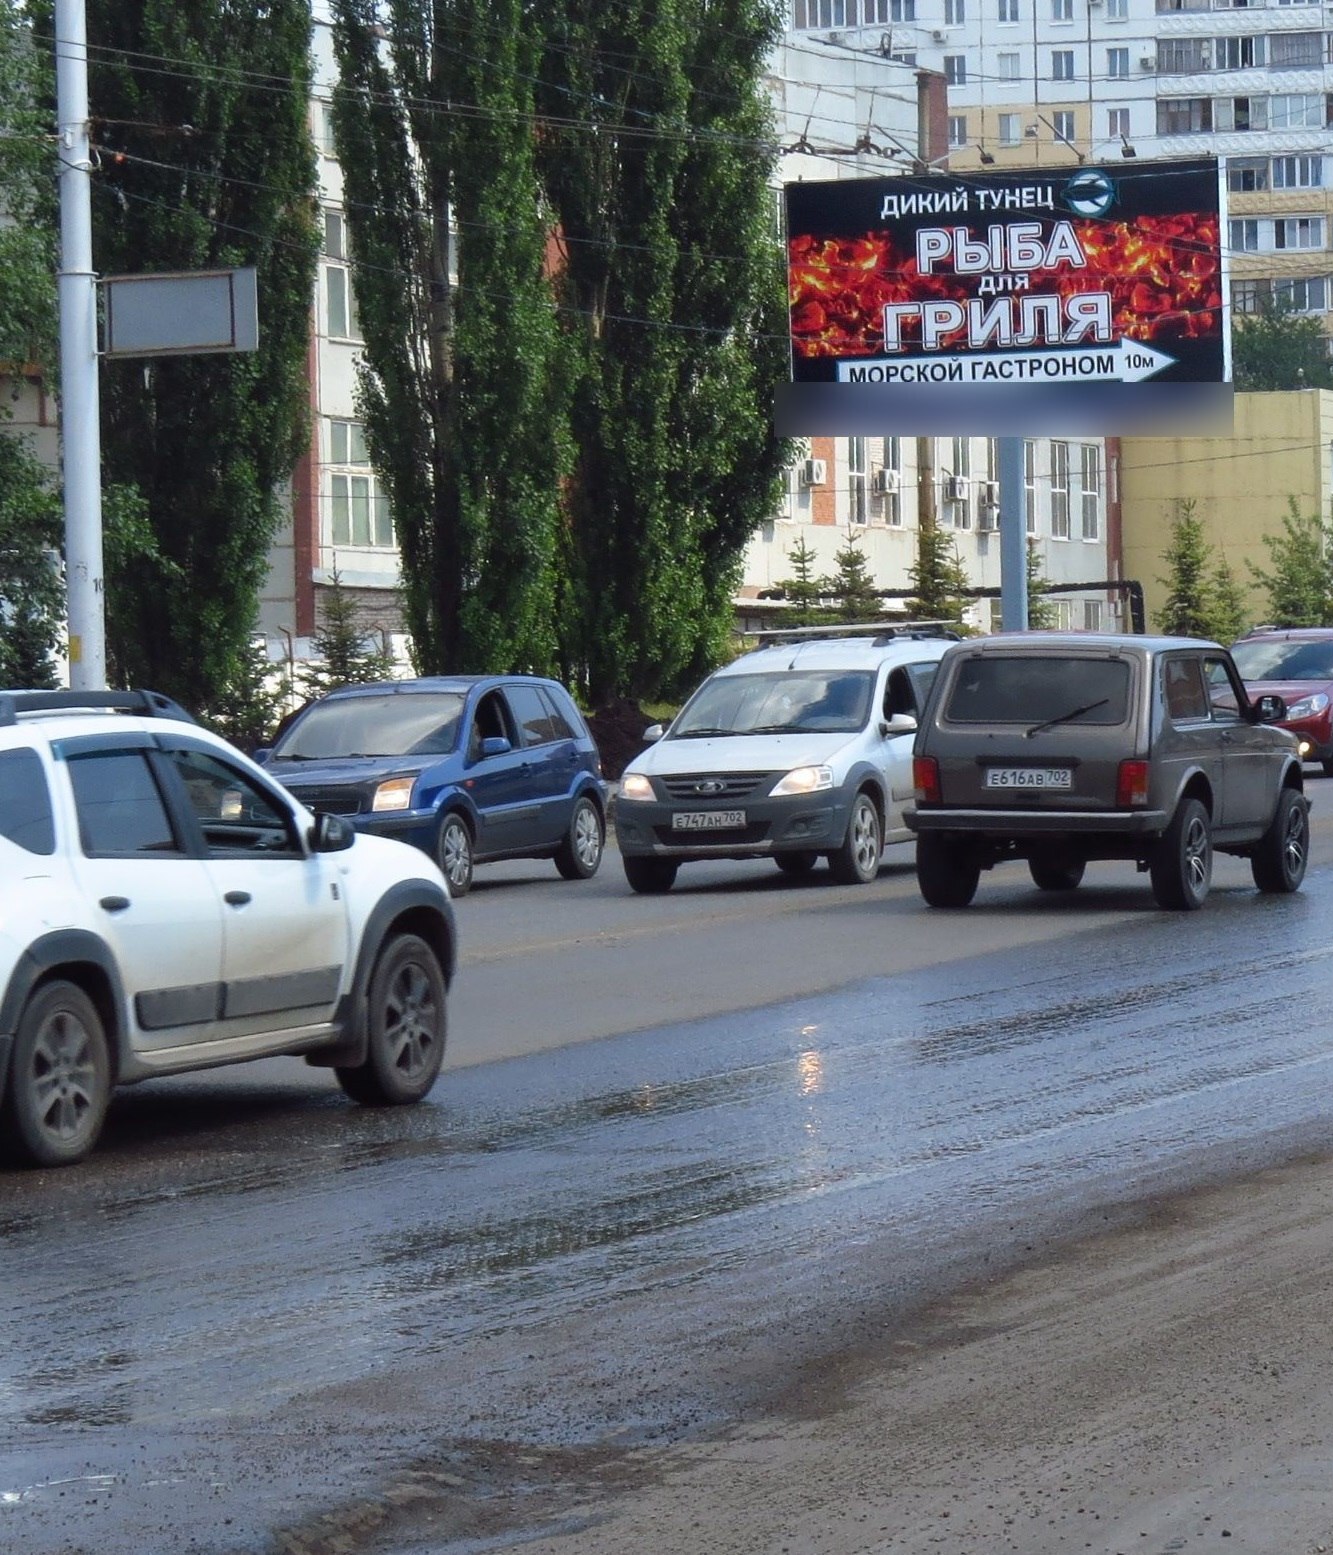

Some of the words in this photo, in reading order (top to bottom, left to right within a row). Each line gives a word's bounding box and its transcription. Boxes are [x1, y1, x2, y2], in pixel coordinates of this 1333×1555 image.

[881, 187, 967, 219] ДИКИЙ
[976, 187, 1054, 210] ТУНЕЦ
[916, 221, 1086, 275] РЫБА
[884, 292, 1113, 353] ГРИЛЯ
[850, 358, 963, 382] МОРСКОЙ
[971, 355, 1114, 380] ГАСТРОНОМ
